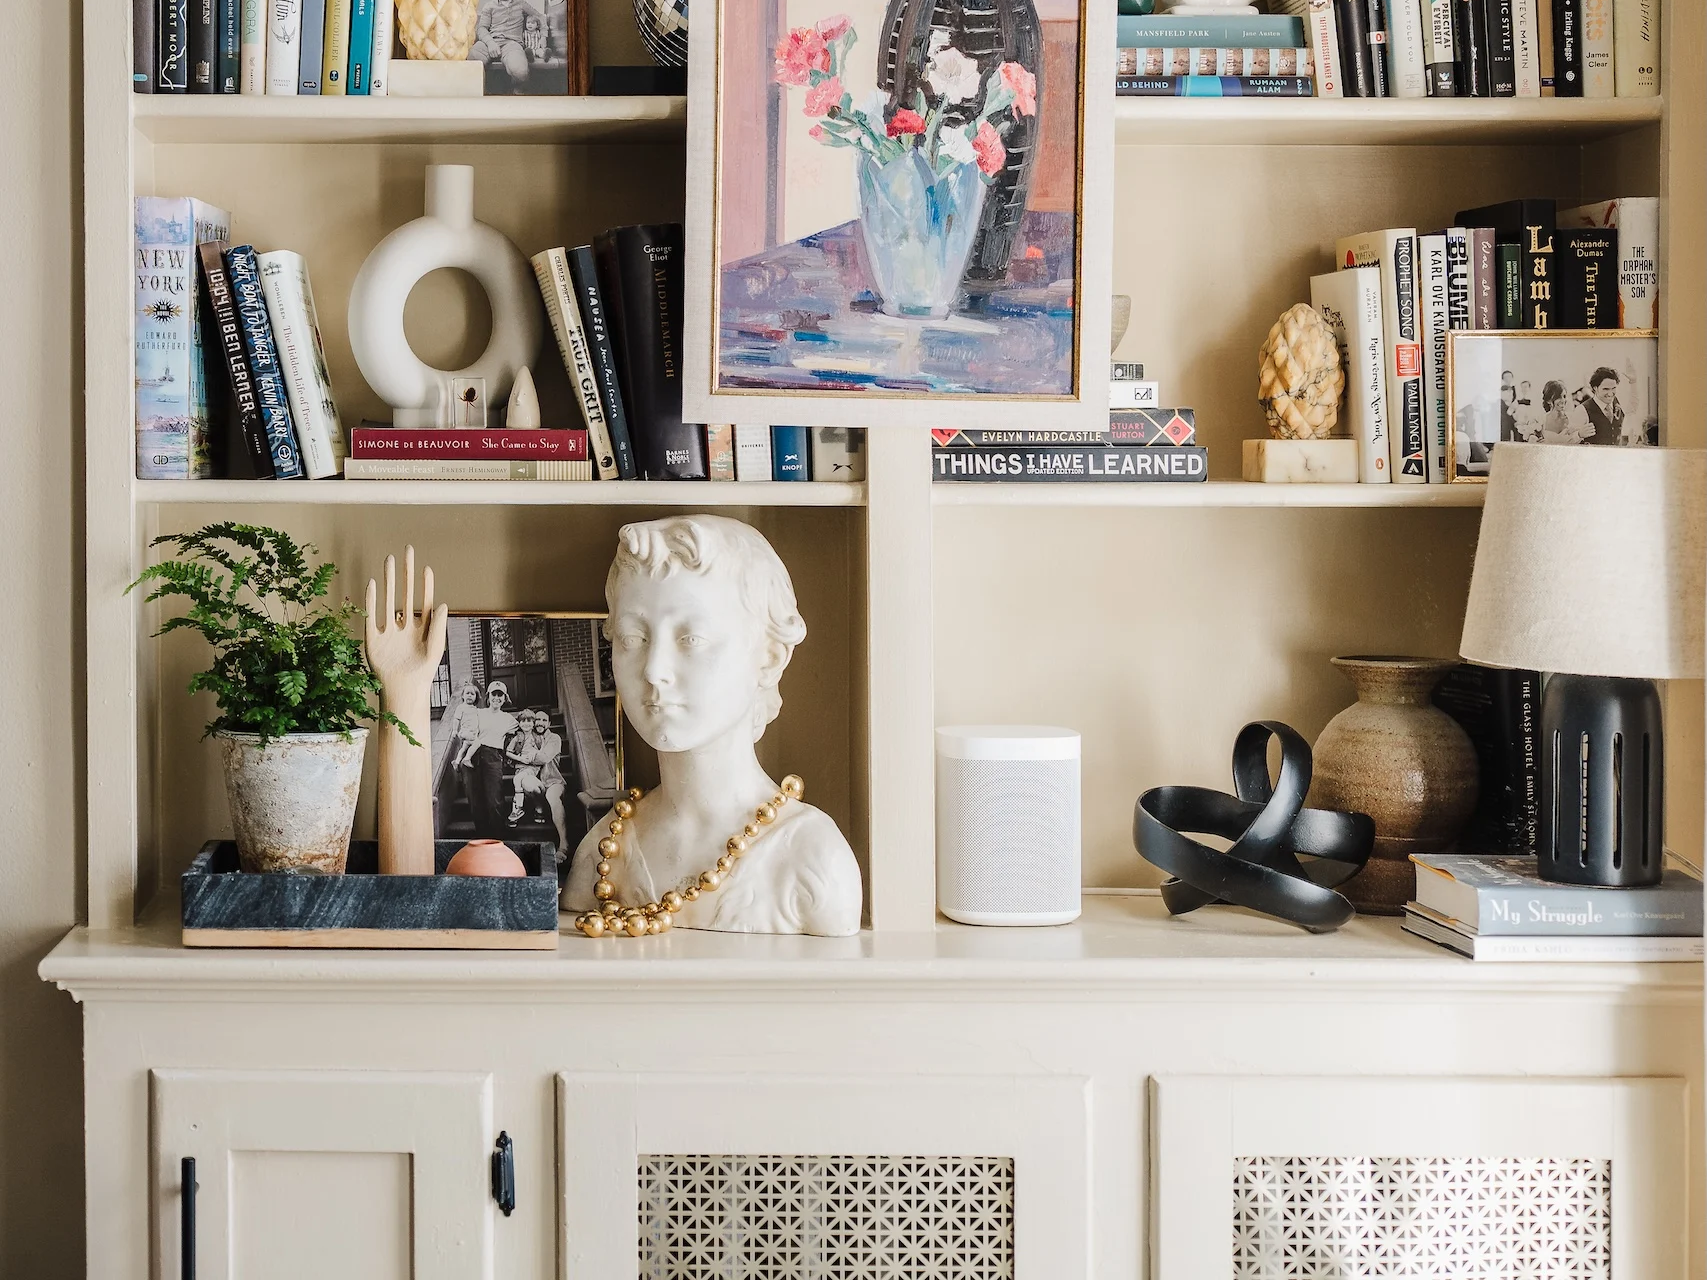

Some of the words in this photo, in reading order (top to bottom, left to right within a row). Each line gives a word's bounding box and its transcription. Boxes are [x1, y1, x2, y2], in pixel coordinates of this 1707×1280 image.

[1433, 8, 1442, 45] EVERETT
[1442, 3, 1451, 48] PERCIVAL
[1501, 18, 1510, 52] STYLE
[168, 34, 177, 71] MOOR
[1520, 30, 1528, 69] MARTIN
[1586, 51, 1610, 59] James
[1588, 60, 1608, 68] Clear
[643, 244, 672, 254] George
[1570, 239, 1609, 249] Alexandre
[1576, 248, 1604, 257] Dumas
[1632, 247, 1645, 258] THE
[137, 249, 186, 269] NEW
[650, 253, 668, 261] Eliot
[1430, 250, 1442, 280] KARL
[1623, 259, 1654, 271] ORPHAN
[1398, 239, 1411, 298] PROPHET
[1526, 225, 1554, 330] Lamb
[1620, 273, 1656, 285] MASTER'S
[137, 275, 186, 295] YORK
[1432, 283, 1444, 307] OVE
[1631, 286, 1647, 298] SON
[587, 286, 604, 342] NAUSEA
[654, 268, 675, 379] MIDDLEMARCH
[1400, 301, 1414, 337] SONG
[146, 331, 177, 339] EDWARD
[136, 341, 186, 351] RUTHERFURD
[1433, 310, 1446, 390] KNAUSGAARD
[260, 375, 278, 411] KEVIN
[269, 407, 288, 438] BARRY
[1402, 382, 1418, 410] PAUL
[982, 431, 1023, 442] EVELYN
[1028, 431, 1101, 442] HARDCASTLE
[1111, 422, 1145, 430] STUART
[1404, 412, 1422, 452] LYNCH
[359, 440, 399, 449] SIMONE
[418, 440, 470, 449] BEAUVOIR
[482, 437, 499, 449] She
[501, 437, 526, 449] Came
[528, 440, 537, 449] to
[539, 437, 560, 453] Stay
[935, 454, 1023, 475] THINGS
[1026, 454, 1036, 468] I
[1039, 454, 1084, 469] HAVE
[1089, 454, 1203, 475] LEARNED
[1522, 680, 1530, 698] THE
[1523, 702, 1532, 732] GLASS
[1524, 737, 1534, 768] HOTEL
[1491, 899, 1521, 924] My
[1528, 900, 1603, 926] Struggle
